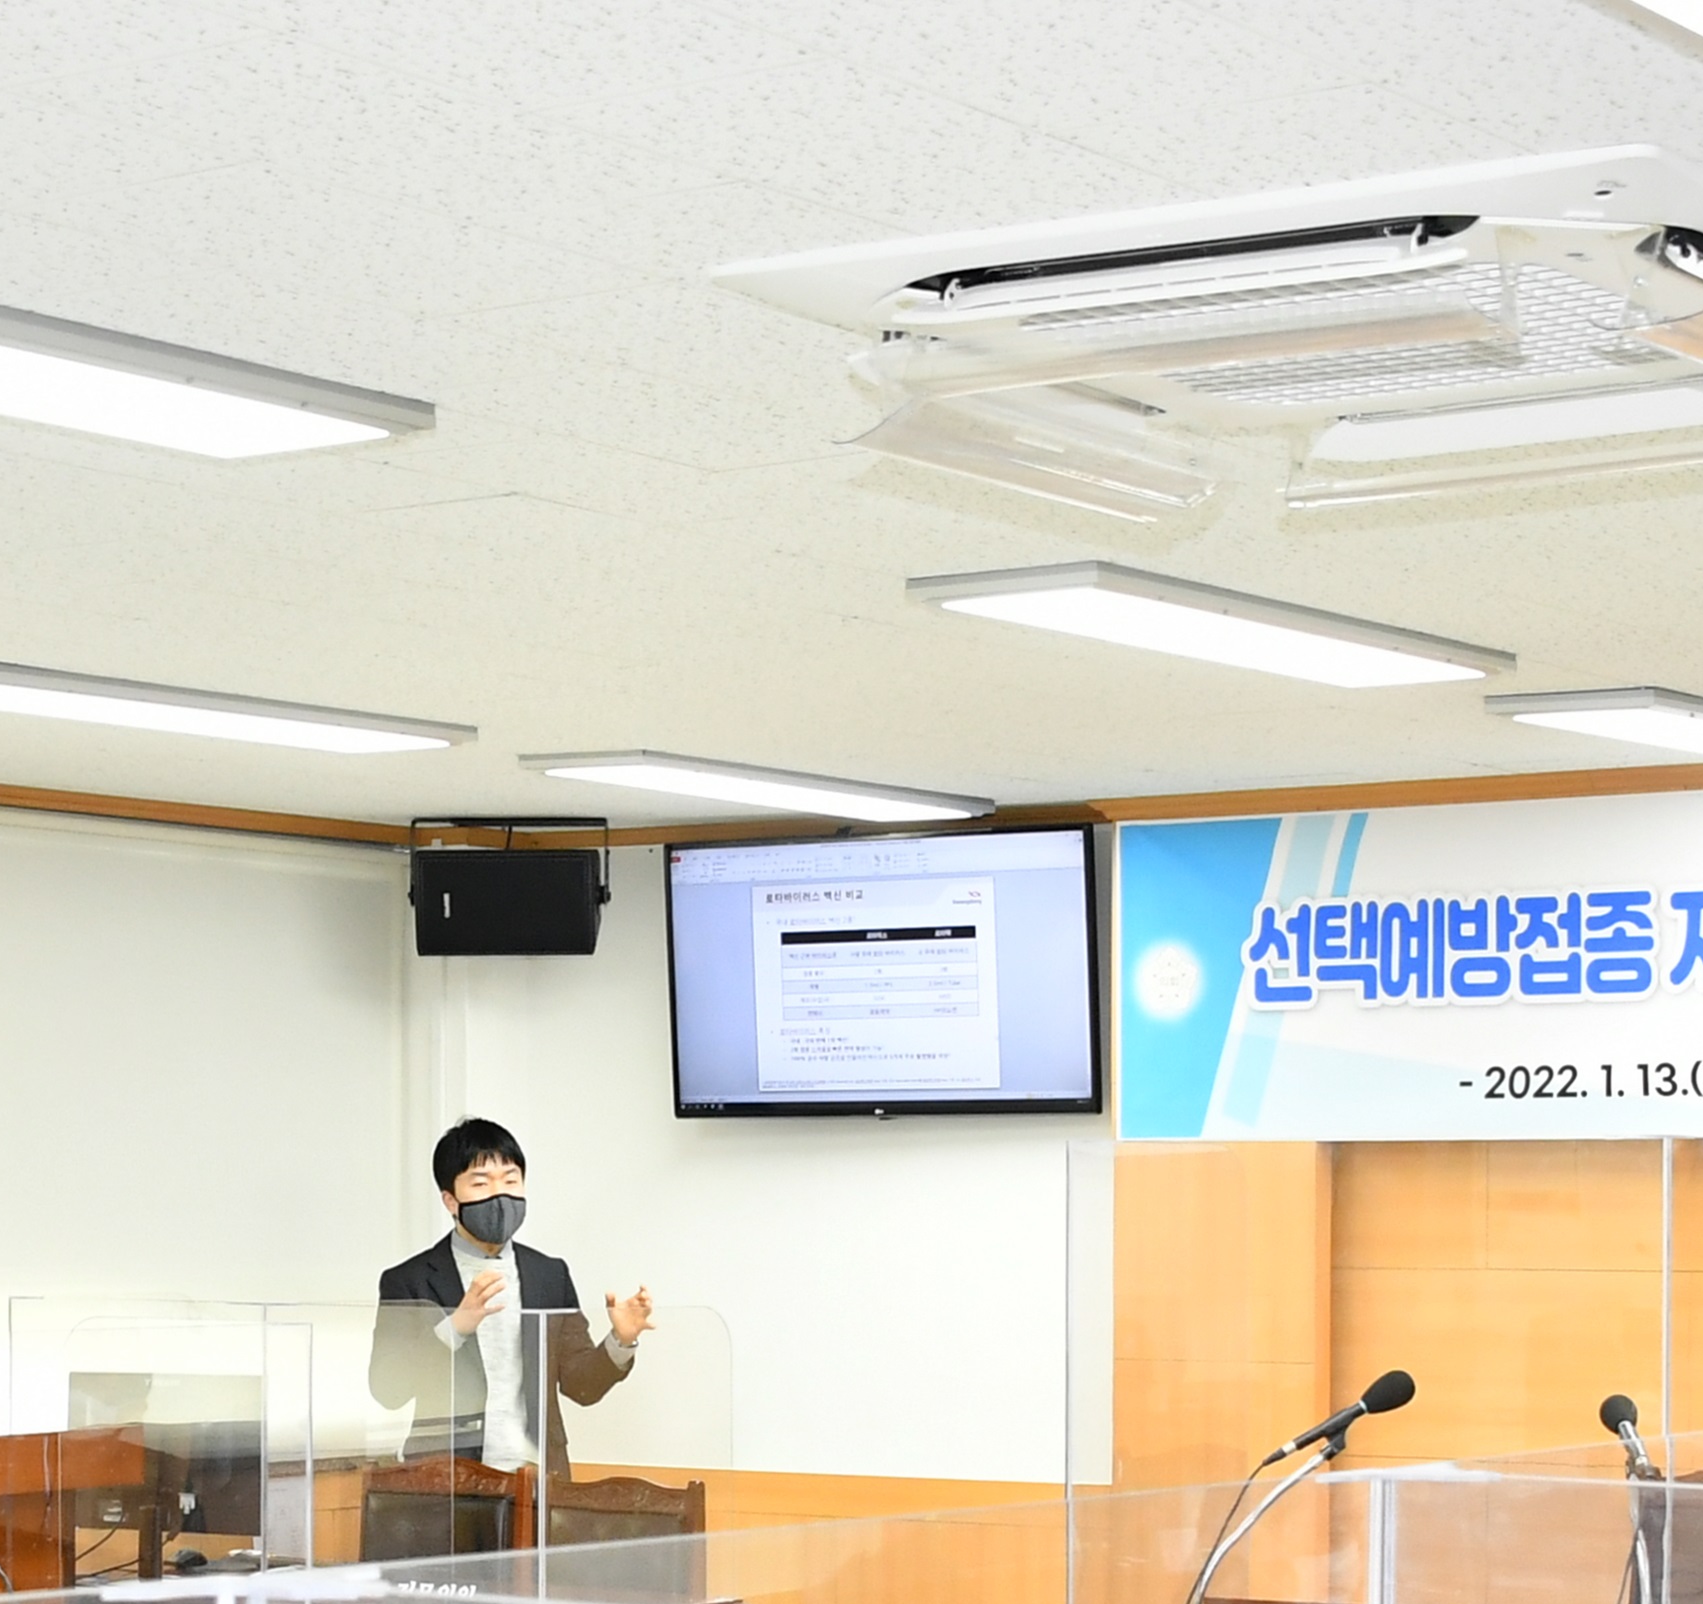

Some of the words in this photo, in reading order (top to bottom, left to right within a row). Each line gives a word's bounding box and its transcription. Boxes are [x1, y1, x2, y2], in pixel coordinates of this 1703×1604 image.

[1249, 892, 1655, 1003] 선택예방접종
[1483, 1064, 1589, 1100] 2022.
[1600, 1063, 1626, 1099] 1.
